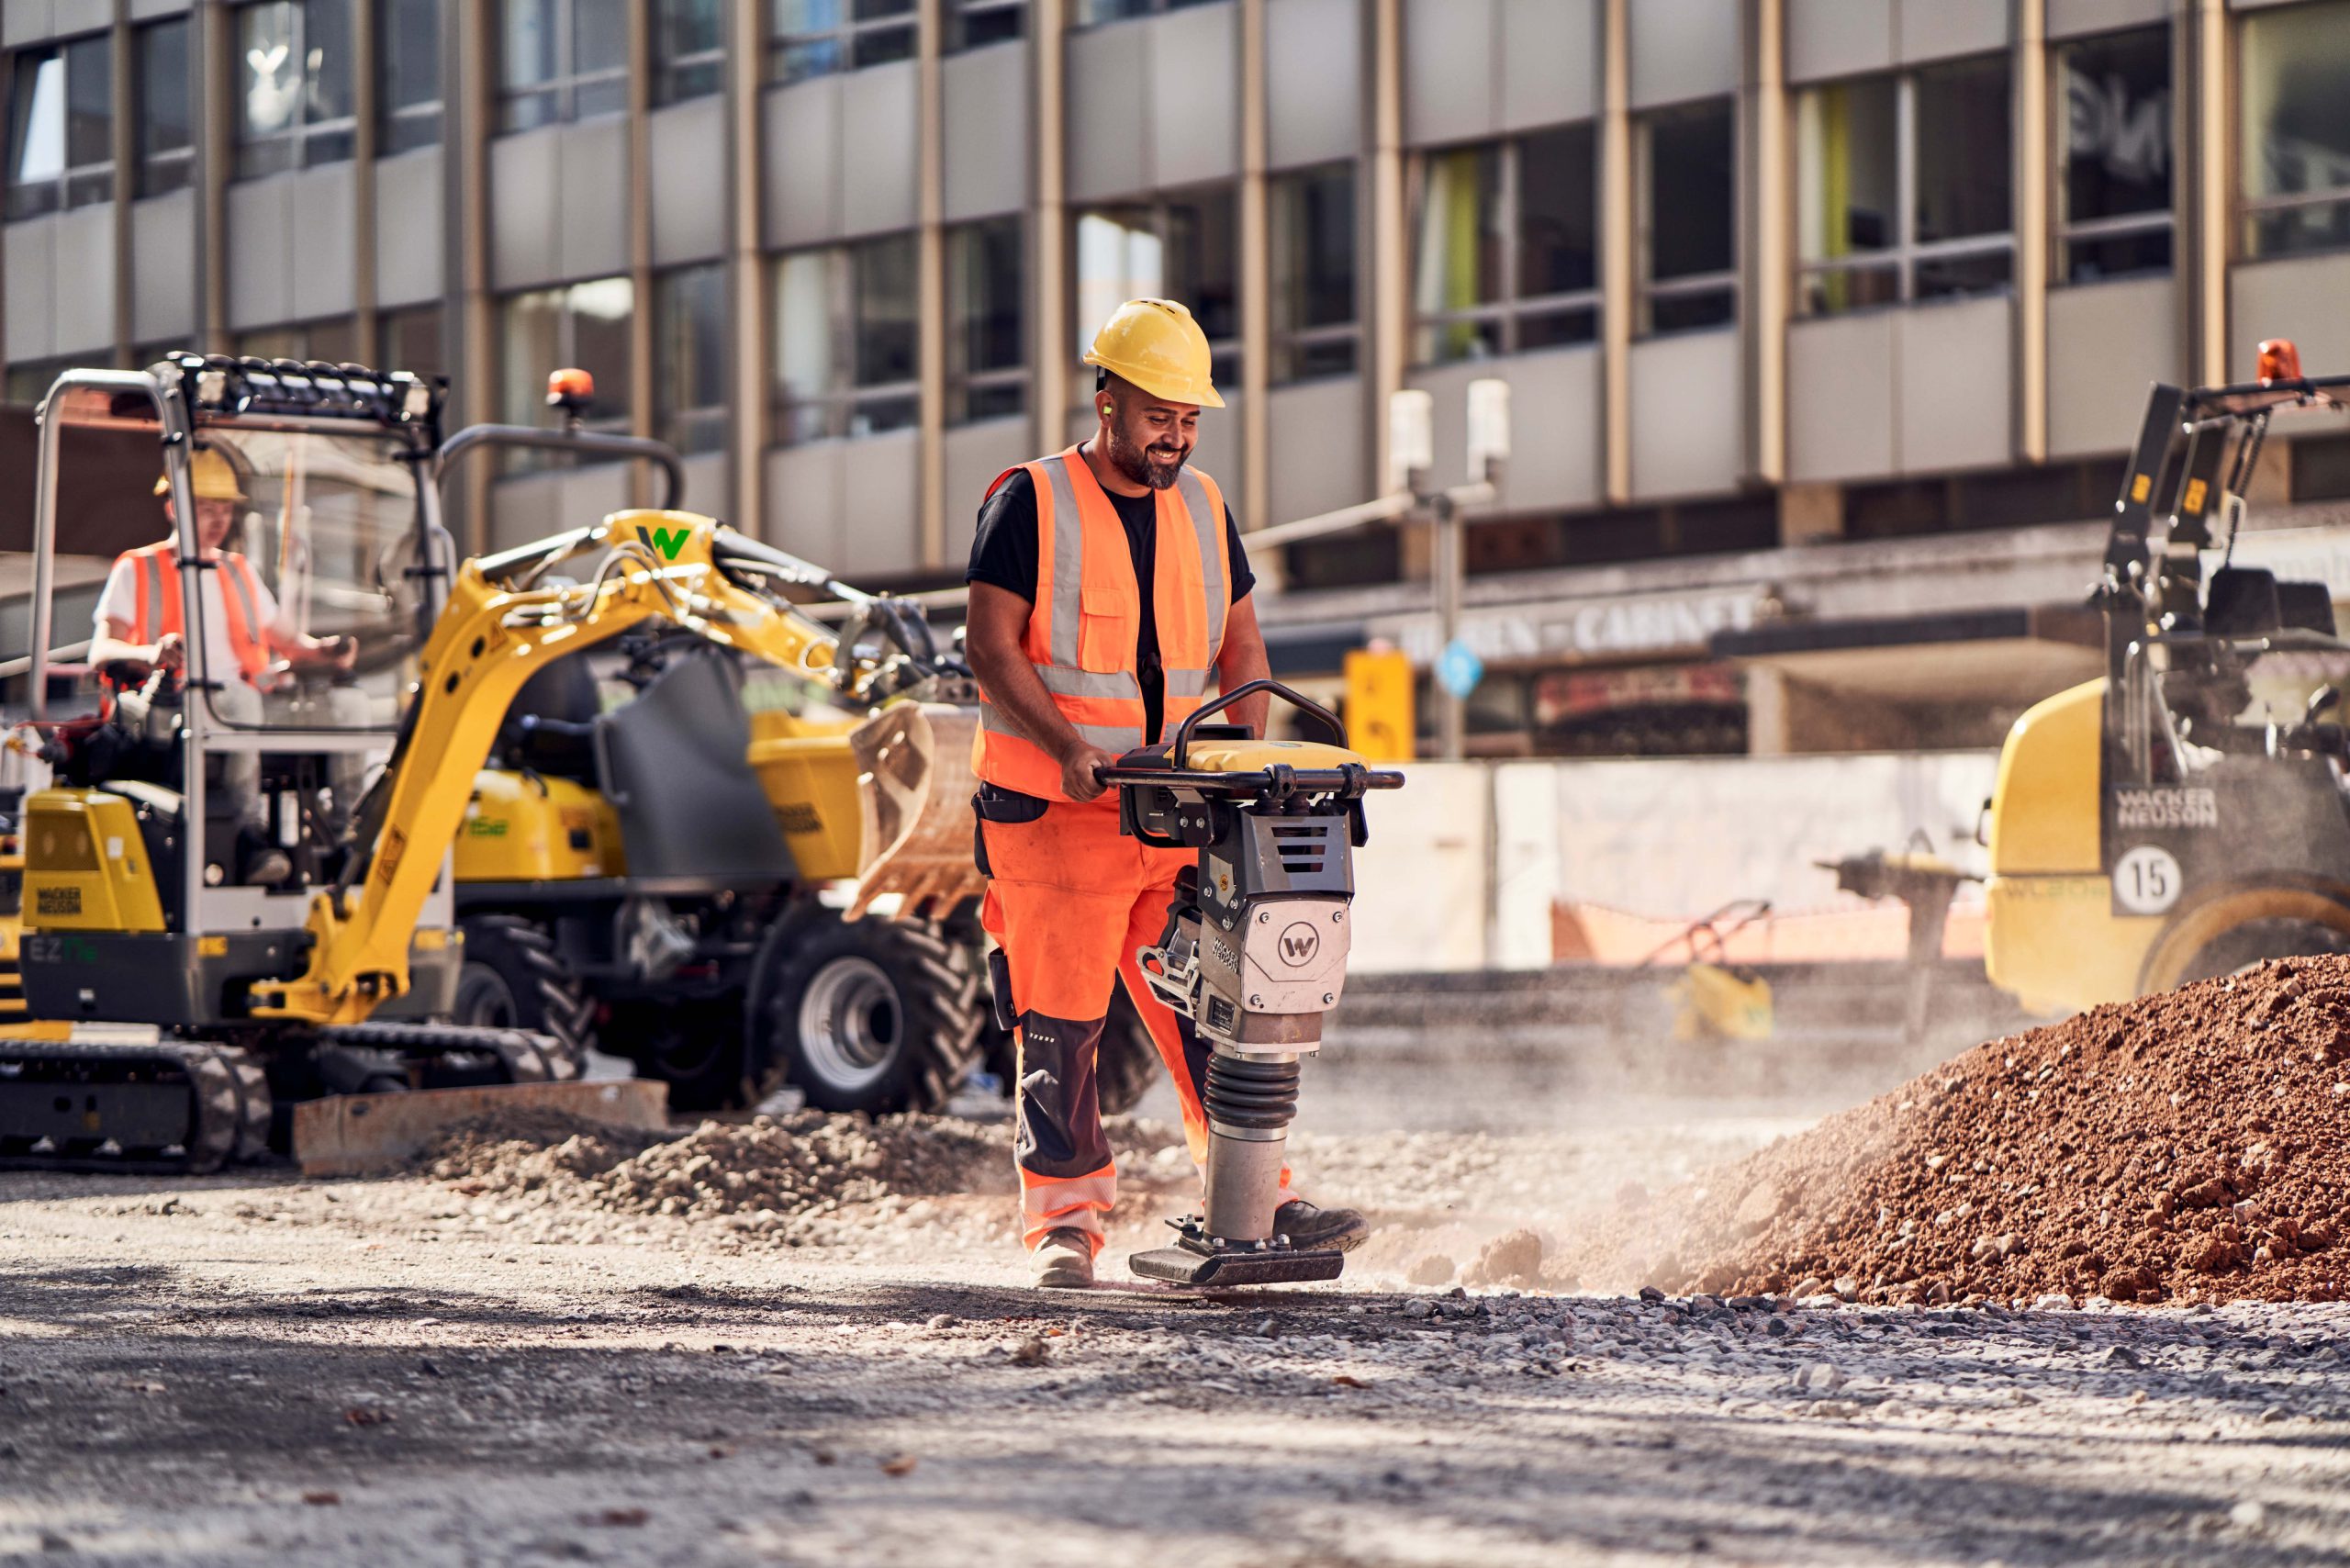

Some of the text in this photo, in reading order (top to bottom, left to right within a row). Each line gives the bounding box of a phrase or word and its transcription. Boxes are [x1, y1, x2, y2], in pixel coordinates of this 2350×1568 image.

[2116, 788, 2216, 806] WACKER
[2117, 805, 2218, 828] NEUSON
[2132, 860, 2166, 897] 15
[1212, 945, 1238, 974] NEUSON
[1214, 935, 1239, 966] WACKER
